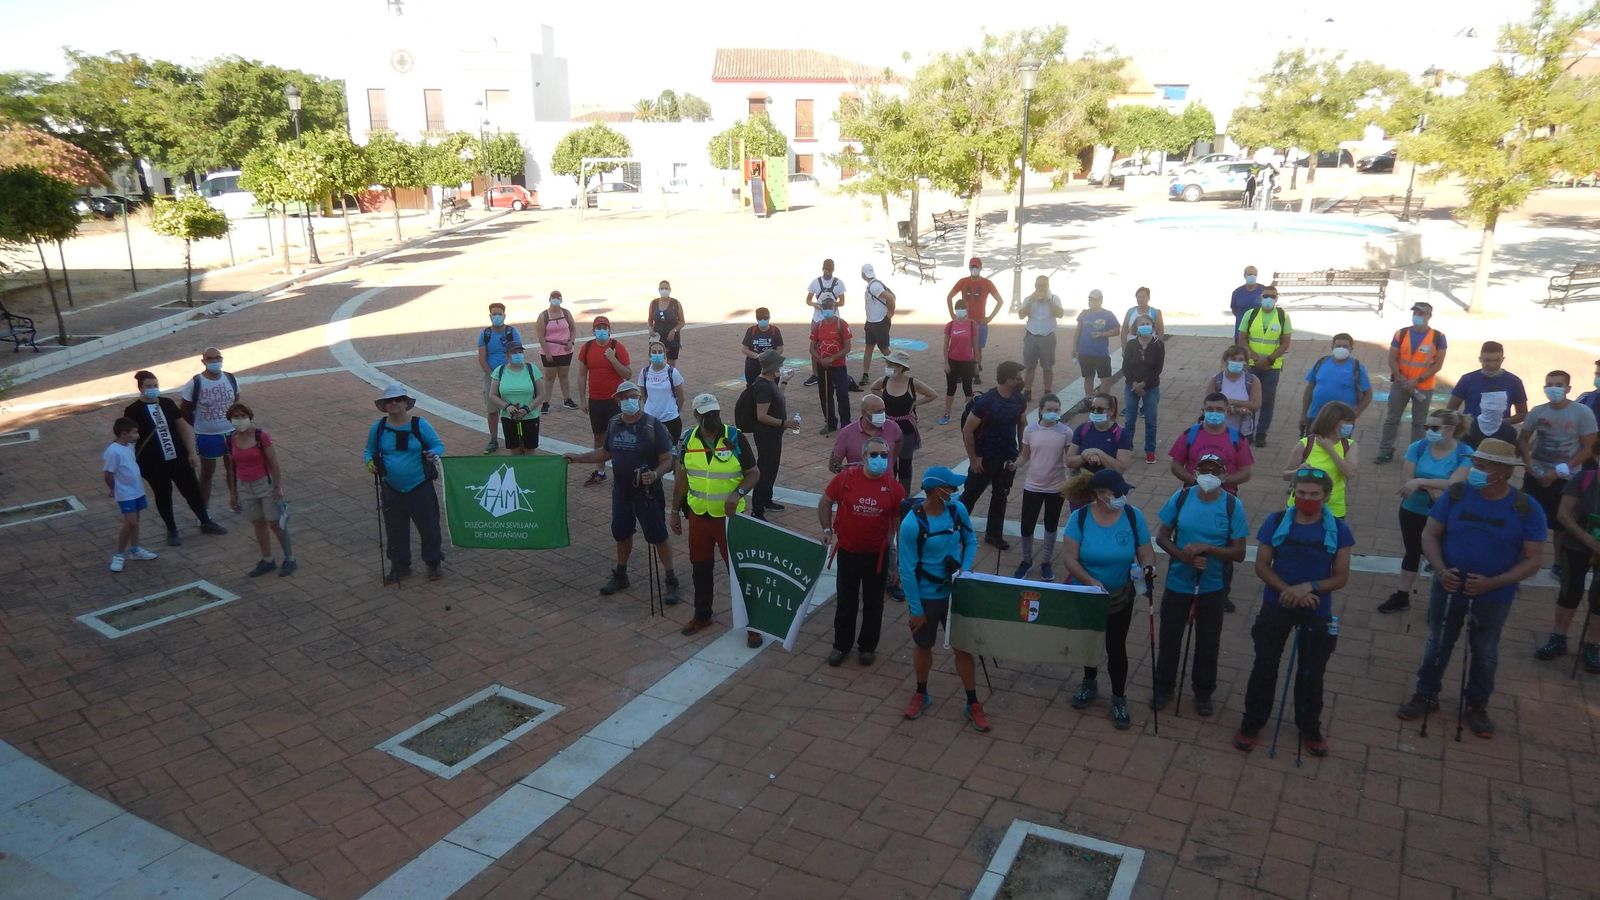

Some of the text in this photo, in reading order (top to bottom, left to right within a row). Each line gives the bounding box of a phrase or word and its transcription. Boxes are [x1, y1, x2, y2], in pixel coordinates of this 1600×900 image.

[484, 489, 516, 512] FAM
[858, 496, 878, 506] edp
[464, 520, 504, 528] DELEGACIÓN
[475, 530, 528, 539] DE MONTAÑISMO
[765, 576, 777, 587] DE
